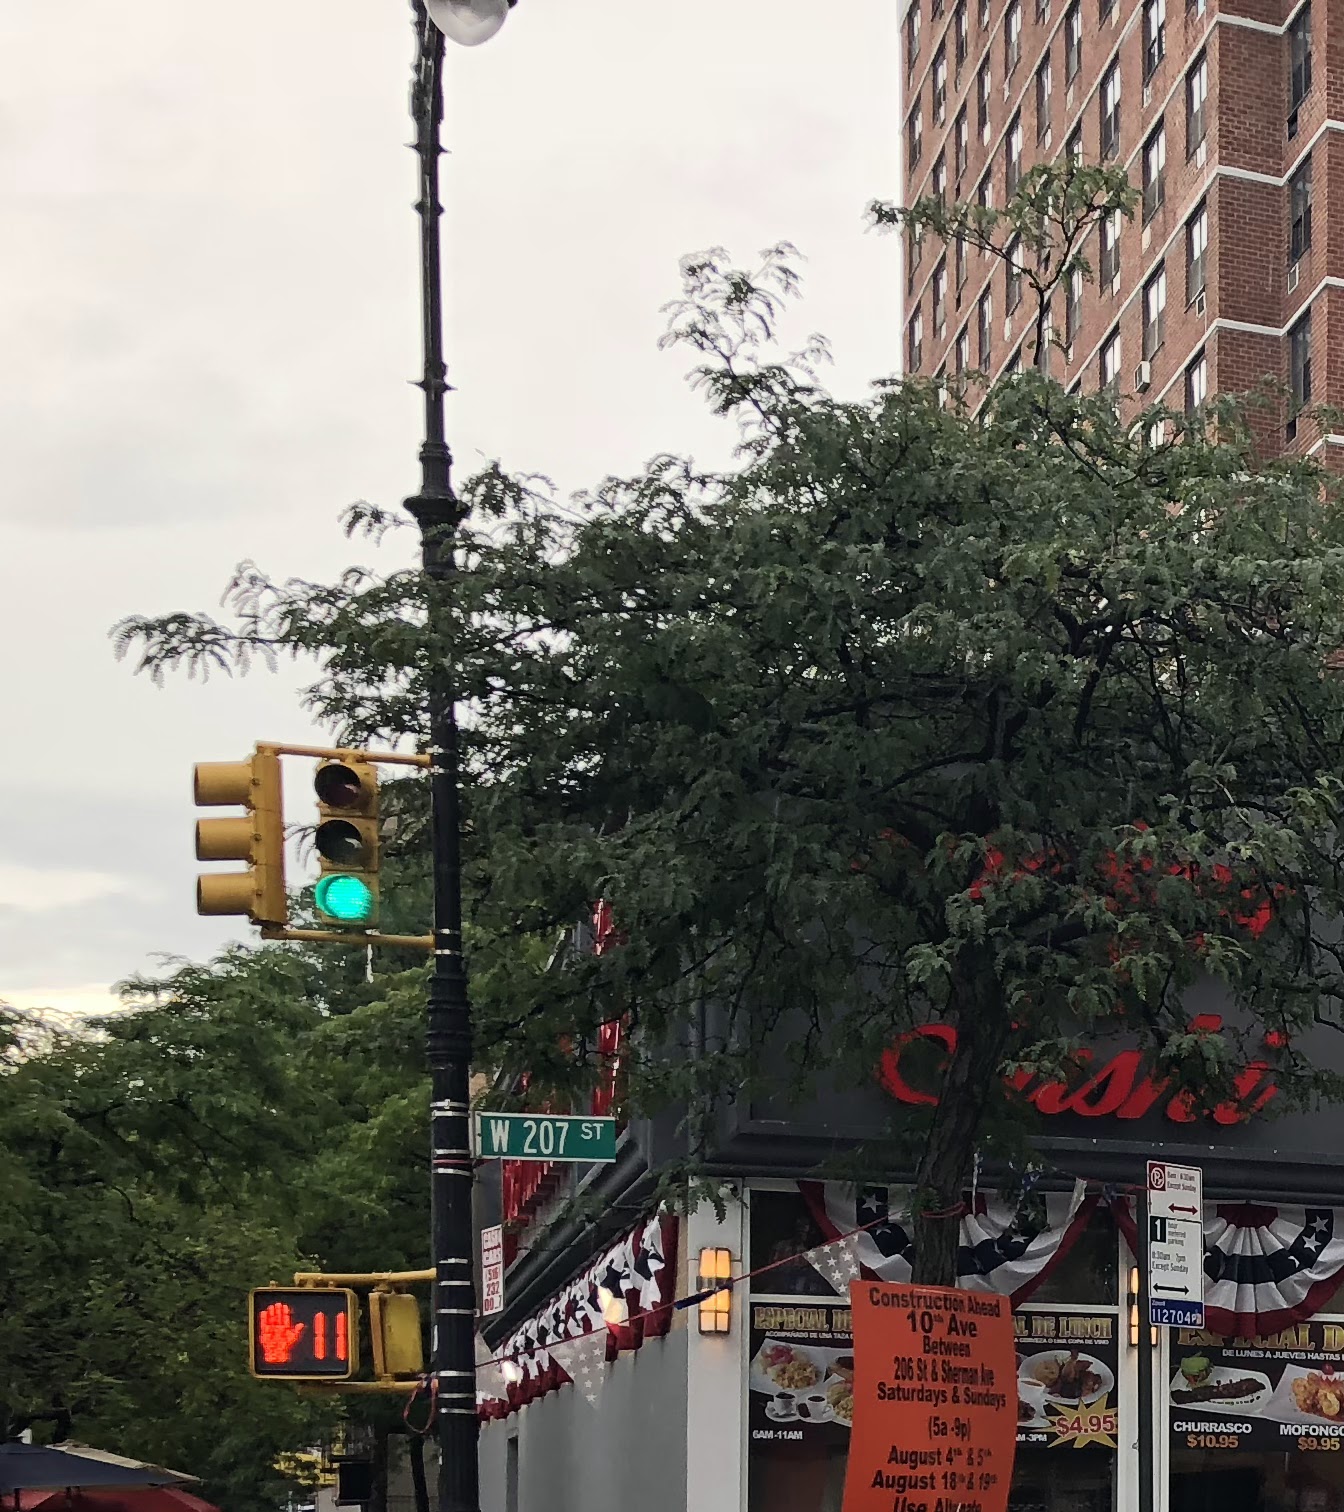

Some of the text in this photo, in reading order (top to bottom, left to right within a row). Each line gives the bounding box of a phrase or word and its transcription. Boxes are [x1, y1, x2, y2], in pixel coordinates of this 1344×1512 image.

[489, 1119, 605, 1155] W 207 ST
[1155, 1218, 1161, 1241] 1
[1170, 1263, 1189, 1275] Sunday
[869, 1287, 1001, 1318] Construction Ahead
[754, 1306, 830, 1331] ESPECIAL
[947, 1313, 978, 1337] Ave
[922, 1335, 971, 1358] Between
[1235, 1349, 1264, 1359] LUNES
[1272, 1351, 1306, 1361] JUEVES
[893, 1356, 914, 1381] 206
[917, 1358, 928, 1381] St
[941, 1359, 978, 1385] Sherman
[877, 1381, 1007, 1411] Saturdays & Sundays
[1055, 1413, 1115, 1438] $4.95
[1173, 1421, 1253, 1435] CHURRASCO
[1186, 1433, 1240, 1450] $10.95
[1298, 1437, 1341, 1453] $9.95
[887, 1445, 942, 1470] August
[871, 1469, 936, 1494] August
